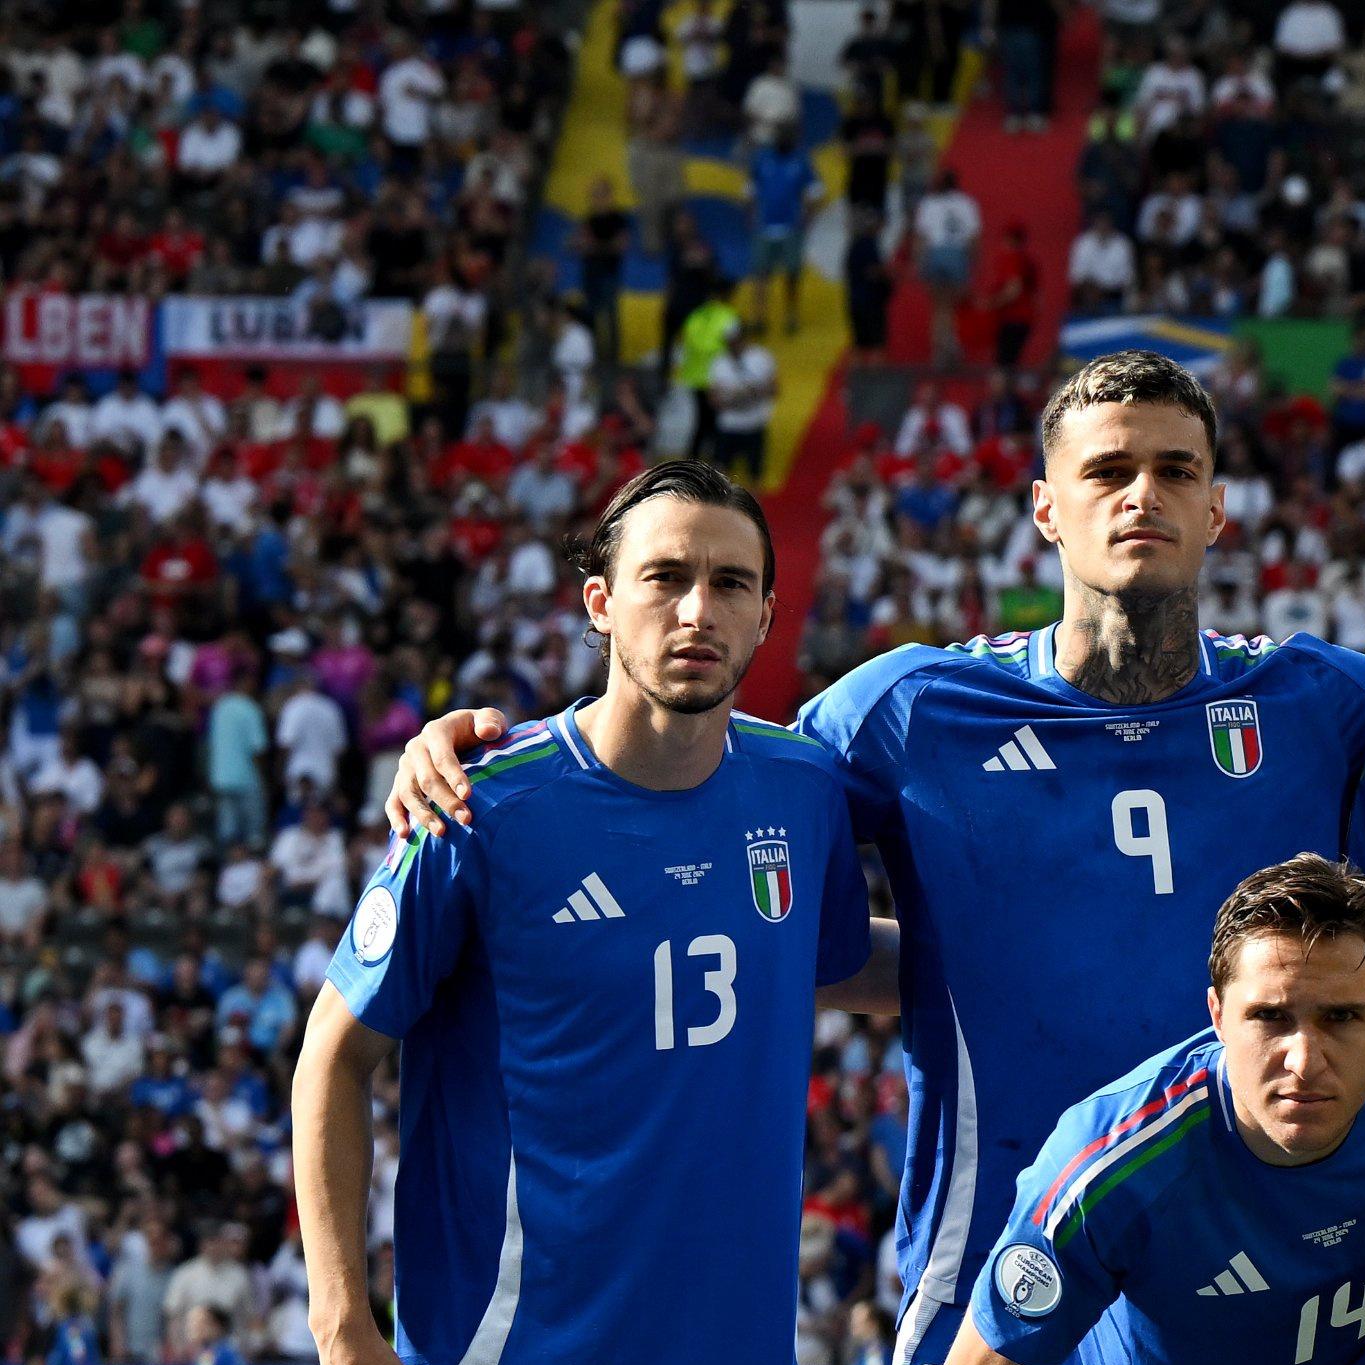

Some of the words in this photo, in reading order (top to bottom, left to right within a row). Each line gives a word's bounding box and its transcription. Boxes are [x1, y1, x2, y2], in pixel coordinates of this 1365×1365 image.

[1210, 706, 1254, 722] ITALIA
[1112, 788, 1173, 894] 9
[751, 847, 786, 864] ITALIA
[654, 933, 738, 1050] 13
[1014, 1260, 1049, 1288] CHAMPIONS
[1017, 1254, 1053, 1282] EUROPEAN
